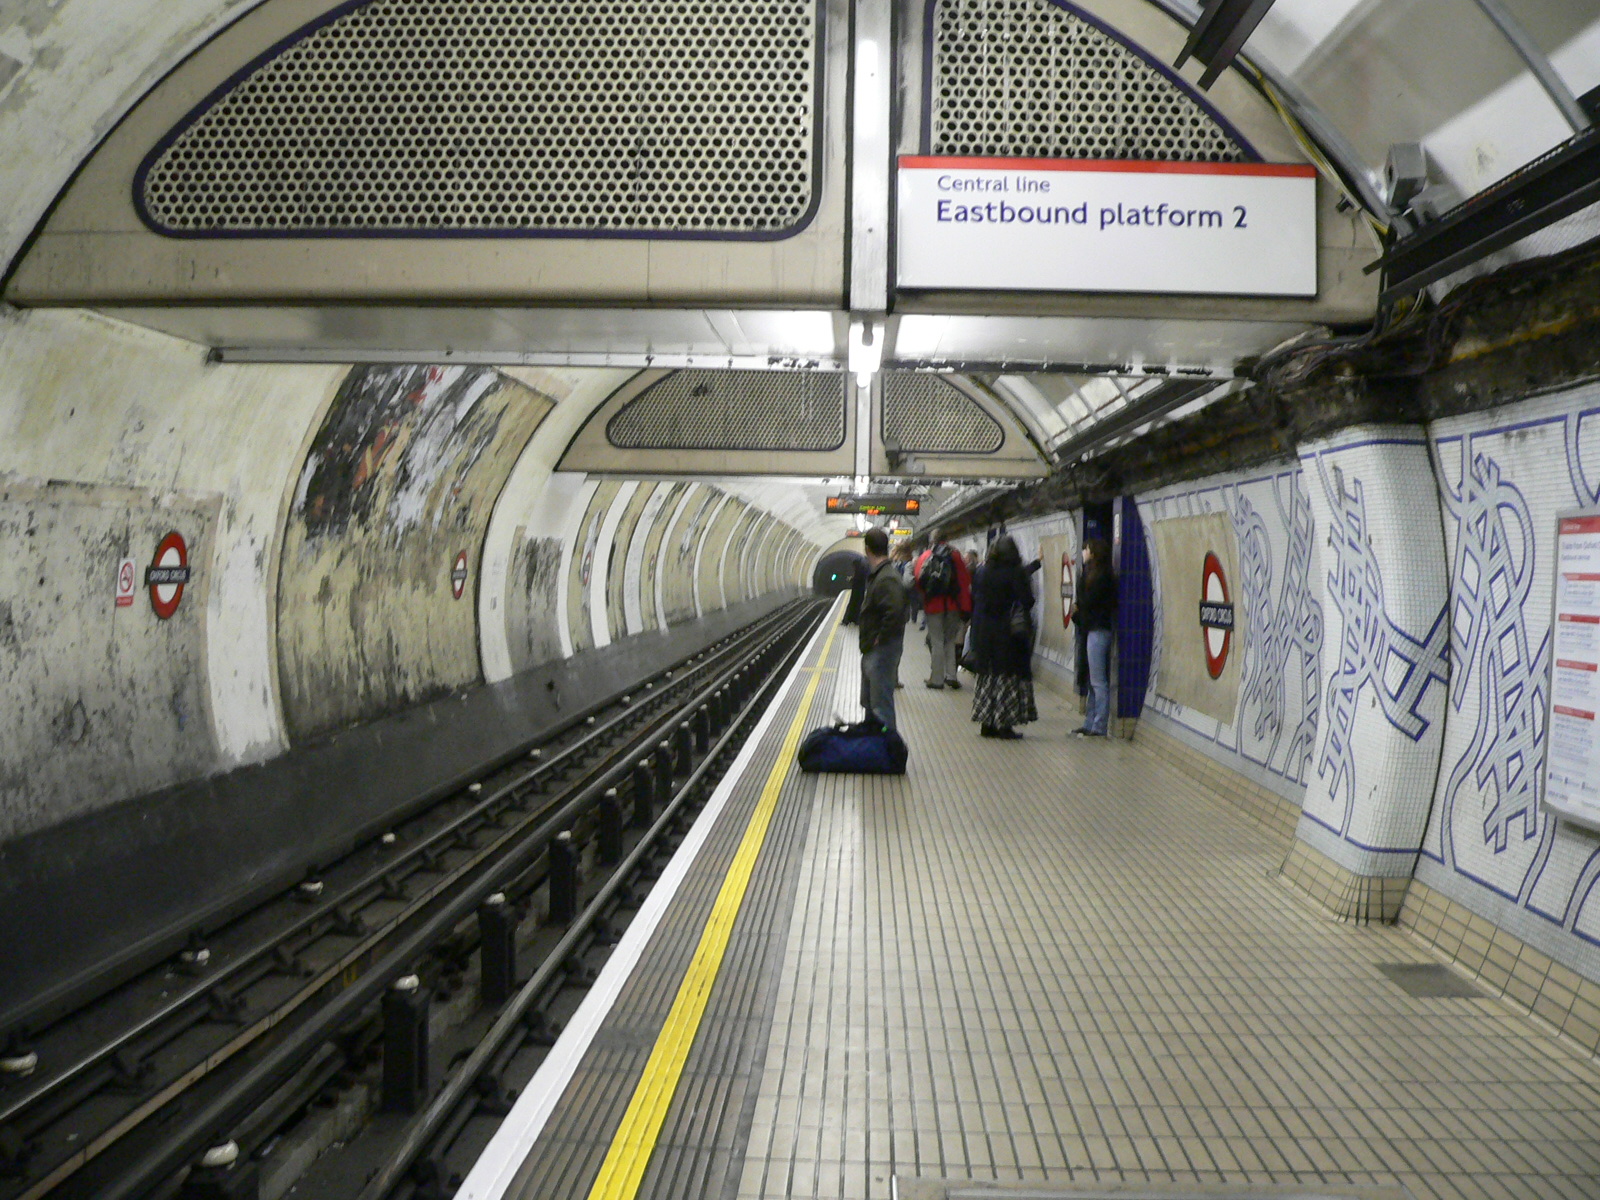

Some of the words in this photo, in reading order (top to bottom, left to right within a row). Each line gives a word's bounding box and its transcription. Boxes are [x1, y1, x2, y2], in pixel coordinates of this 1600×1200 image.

[937, 174, 1009, 192] Central
[1016, 175, 1051, 193] line
[937, 199, 1088, 224] Eastbound
[1100, 201, 1223, 231] platform
[1233, 204, 1248, 229] 2
